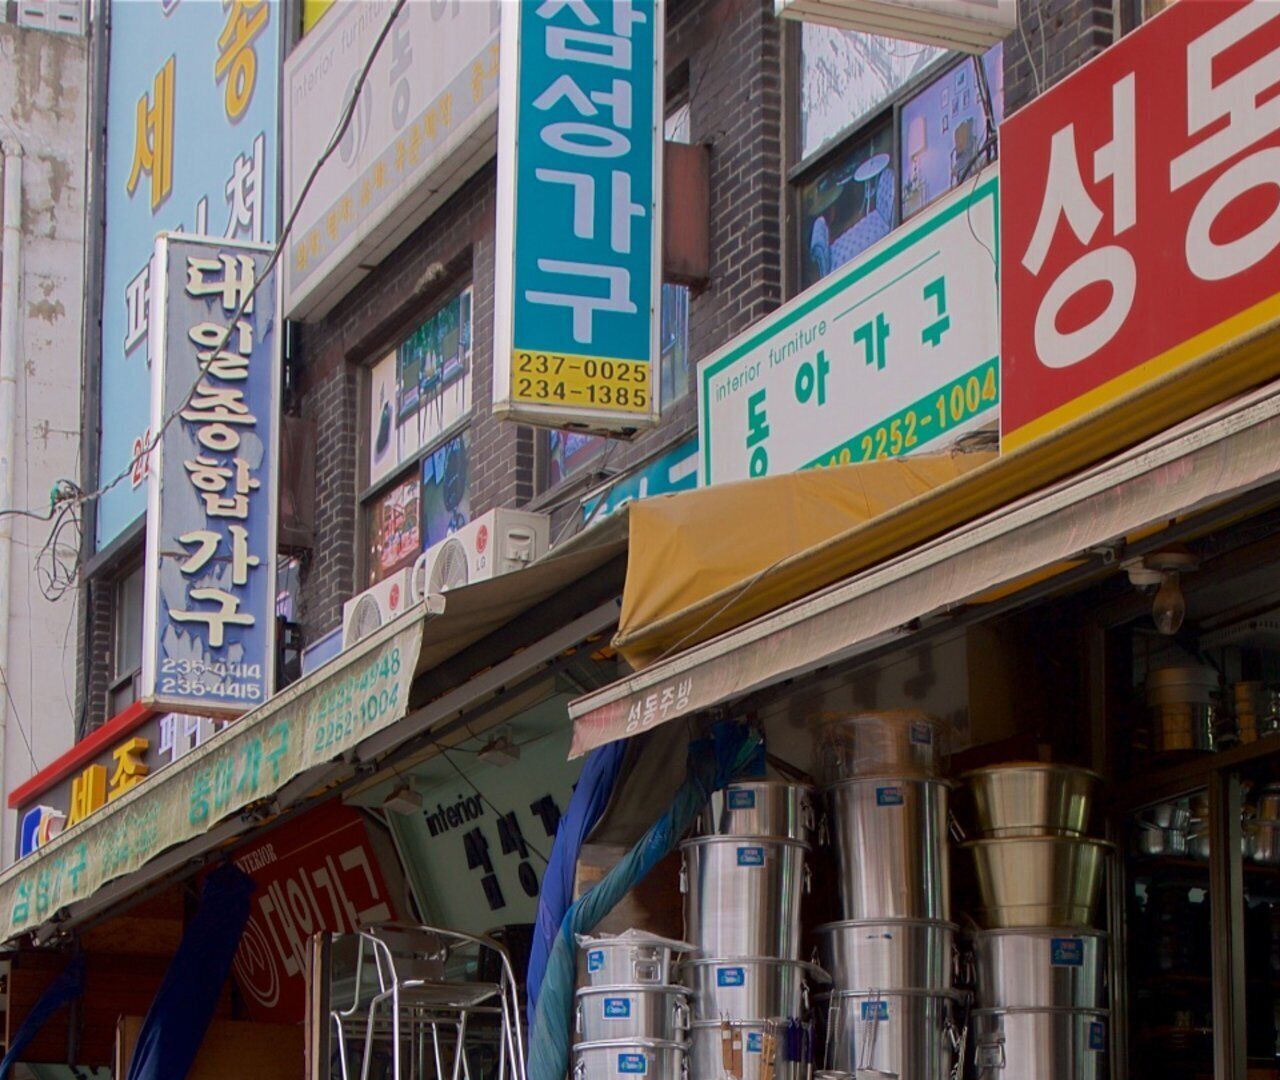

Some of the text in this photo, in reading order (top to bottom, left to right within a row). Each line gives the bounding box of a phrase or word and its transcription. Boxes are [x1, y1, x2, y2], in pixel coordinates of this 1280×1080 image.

[522, 0, 646, 344] 삼성가구
[518, 353, 646, 383] 237-0025
[518, 377, 646, 408] 234-1385
[715, 318, 827, 402] interior furniture
[746, 276, 951, 478] 동아가구
[862, 366, 997, 464] 2252-1004
[626, 677, 694, 733] 성동주방
[423, 793, 484, 838] interior
